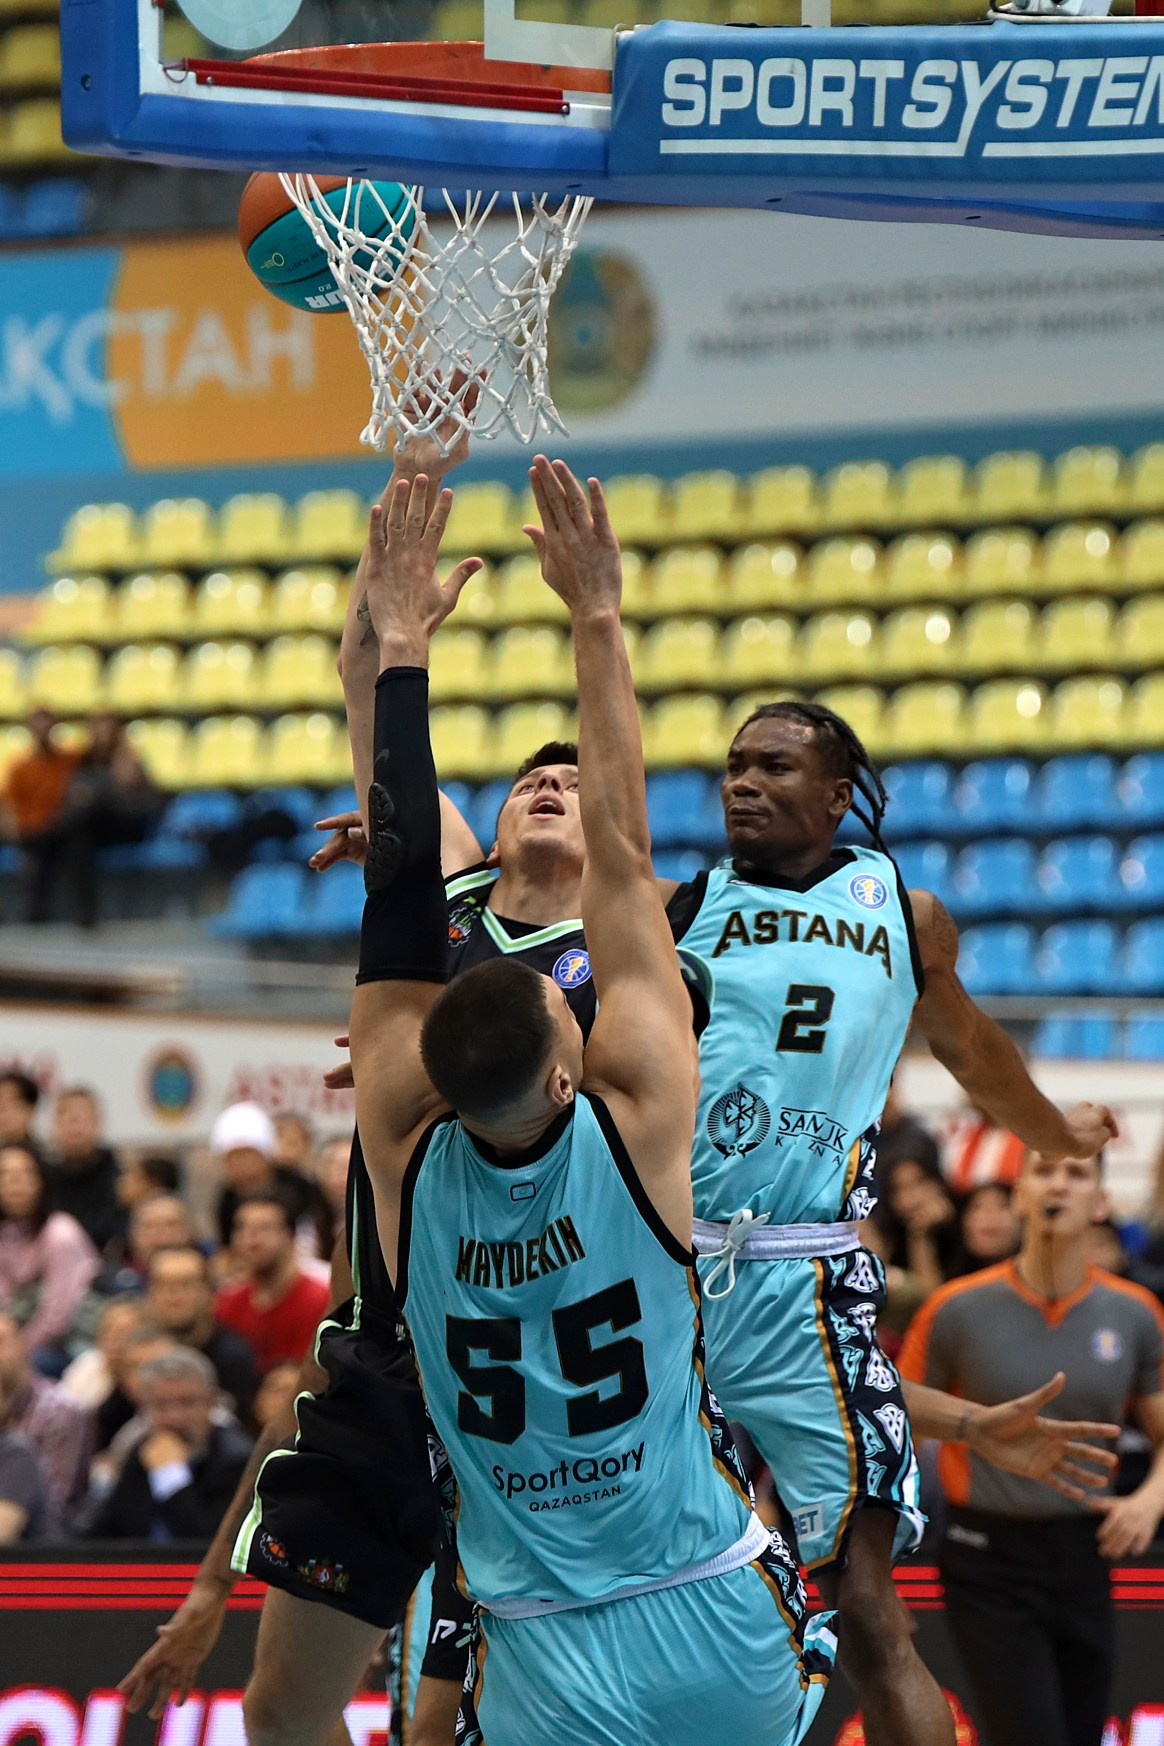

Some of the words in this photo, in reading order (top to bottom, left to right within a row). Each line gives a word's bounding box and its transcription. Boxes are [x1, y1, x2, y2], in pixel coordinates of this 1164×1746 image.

[711, 909, 892, 979] ASTANA
[775, 983, 836, 1054] 2
[445, 1276, 650, 1445] 55
[492, 1441, 645, 1499] SportQory
[529, 1485, 622, 1513] QAZAQSTAN
